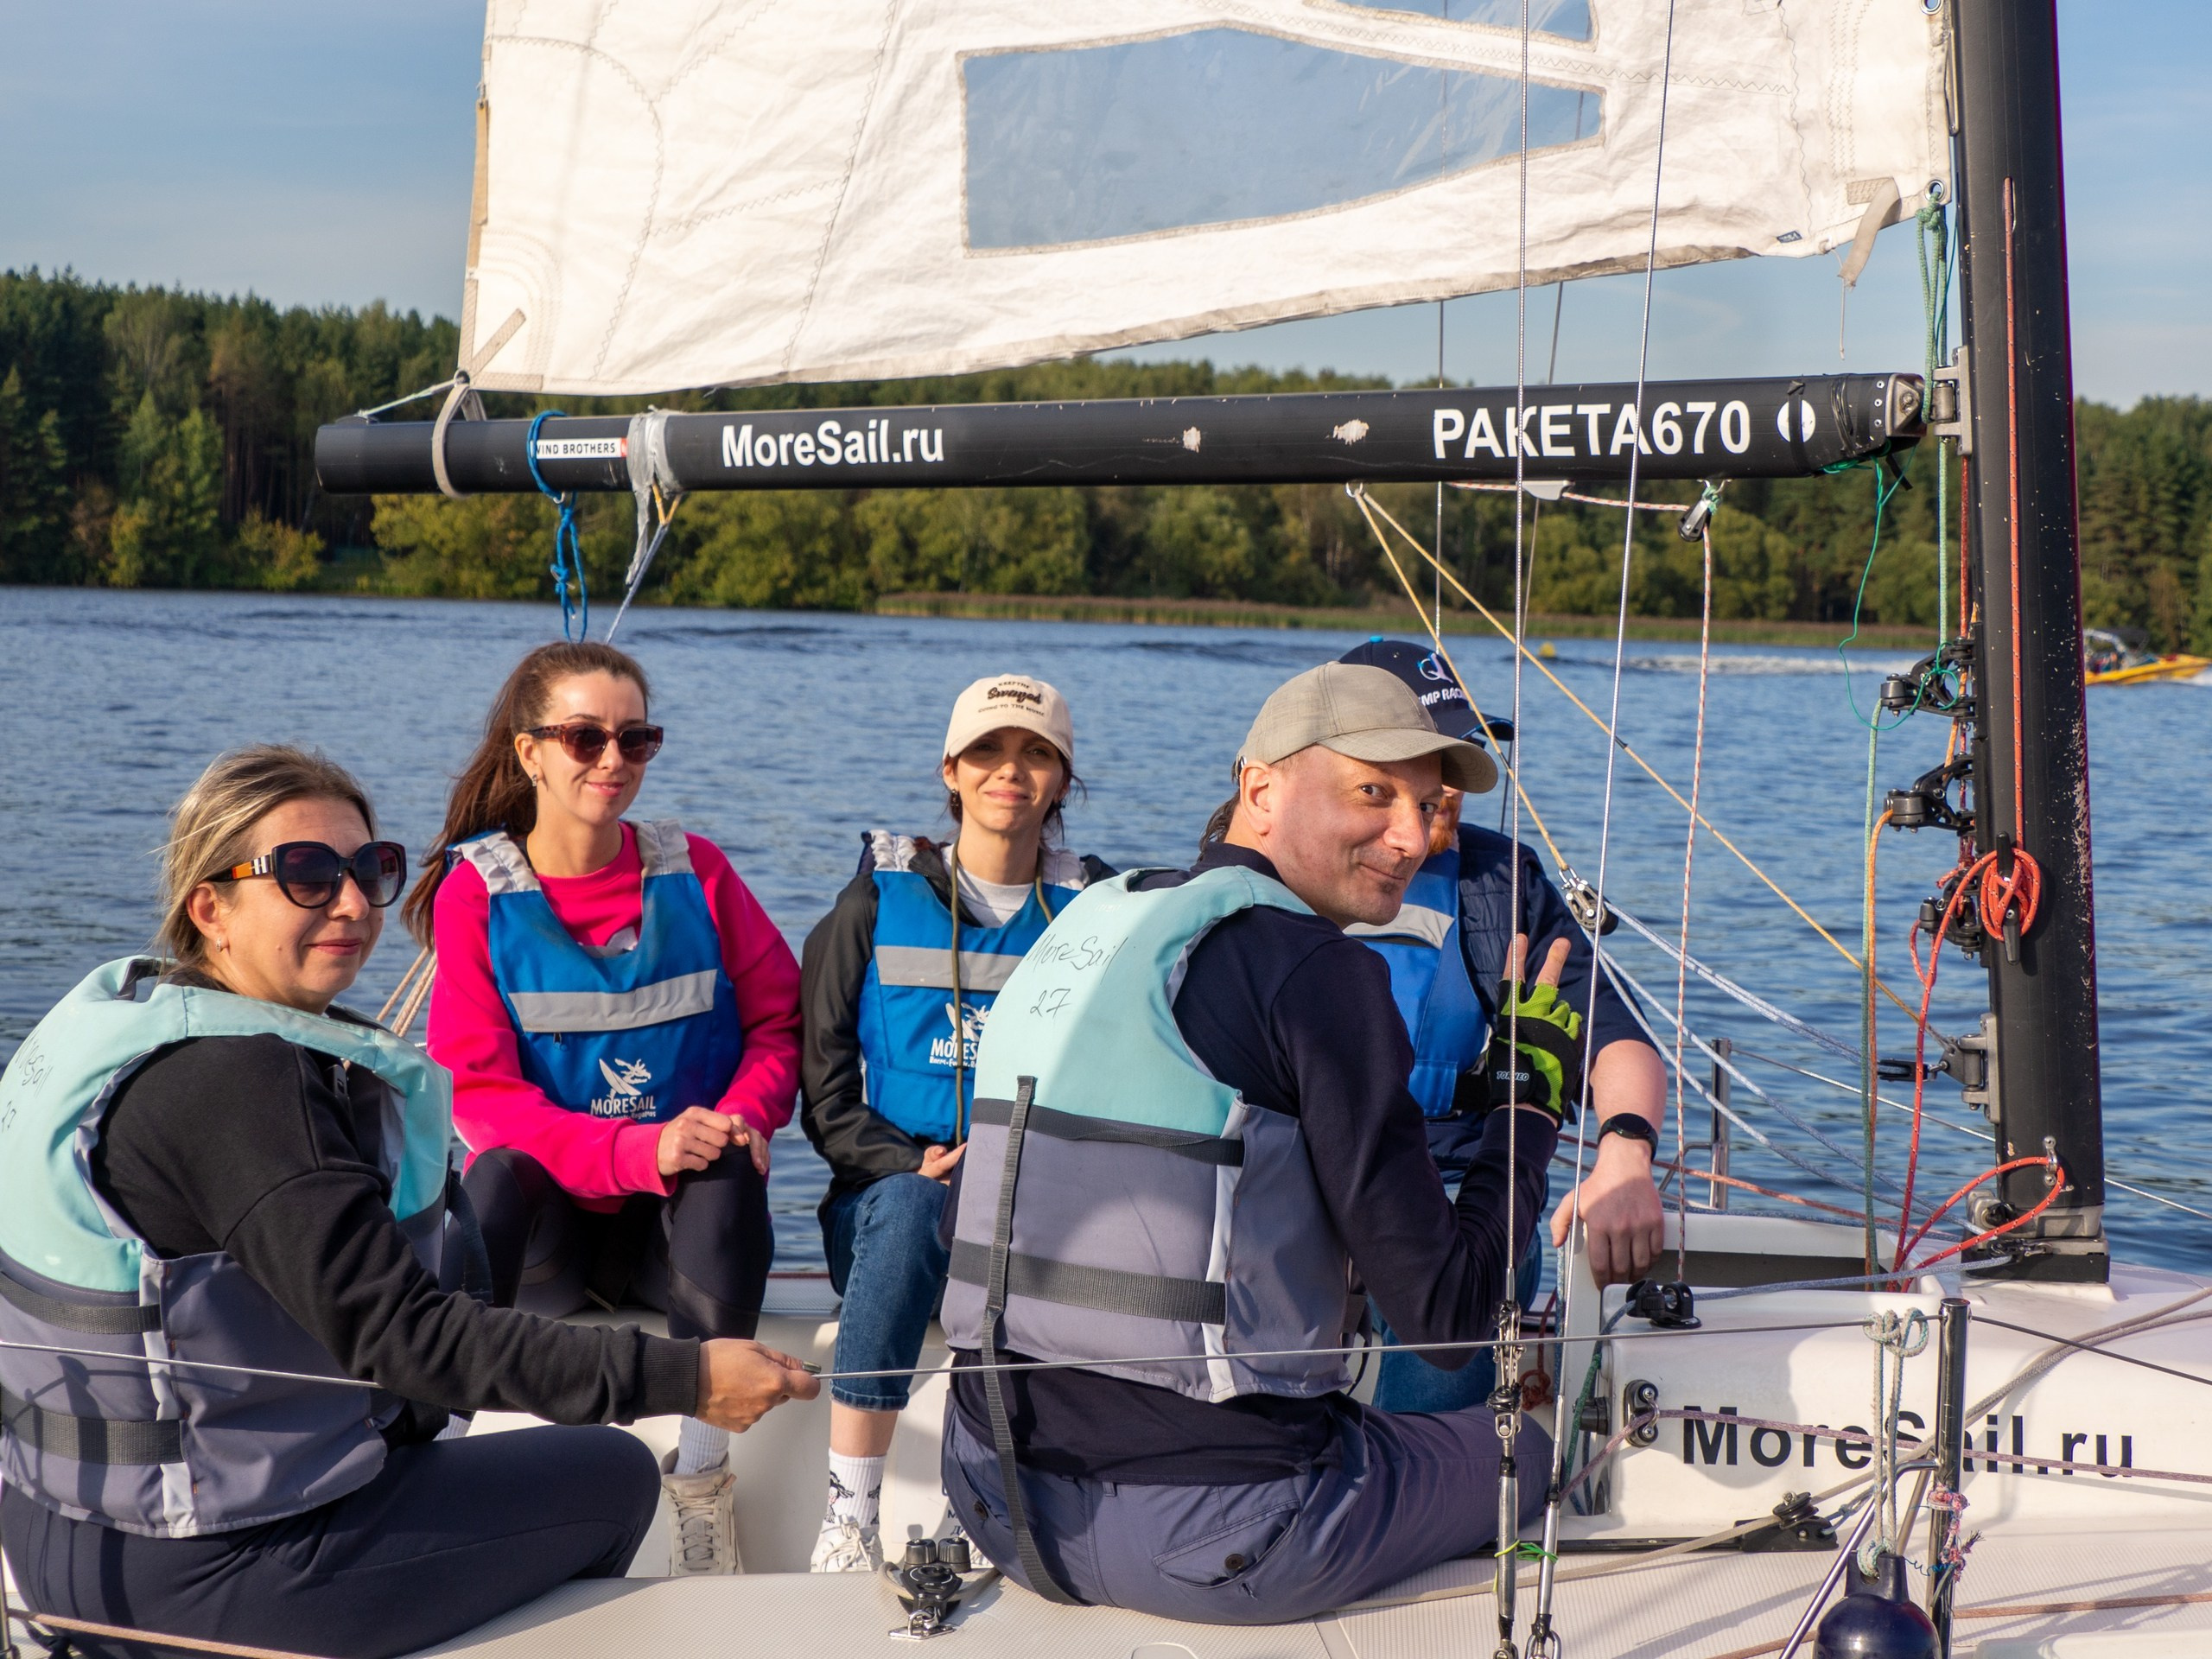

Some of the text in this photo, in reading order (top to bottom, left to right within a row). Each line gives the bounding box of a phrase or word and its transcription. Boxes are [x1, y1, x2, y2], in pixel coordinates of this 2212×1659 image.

[563, 442, 615, 454] BROTHERS
[722, 419, 944, 467] MoreSail.ru
[1419, 690, 1440, 706] MP
[590, 1095, 656, 1116] MORESAIL
[1682, 1405, 2132, 1478] MoreSil.ru
